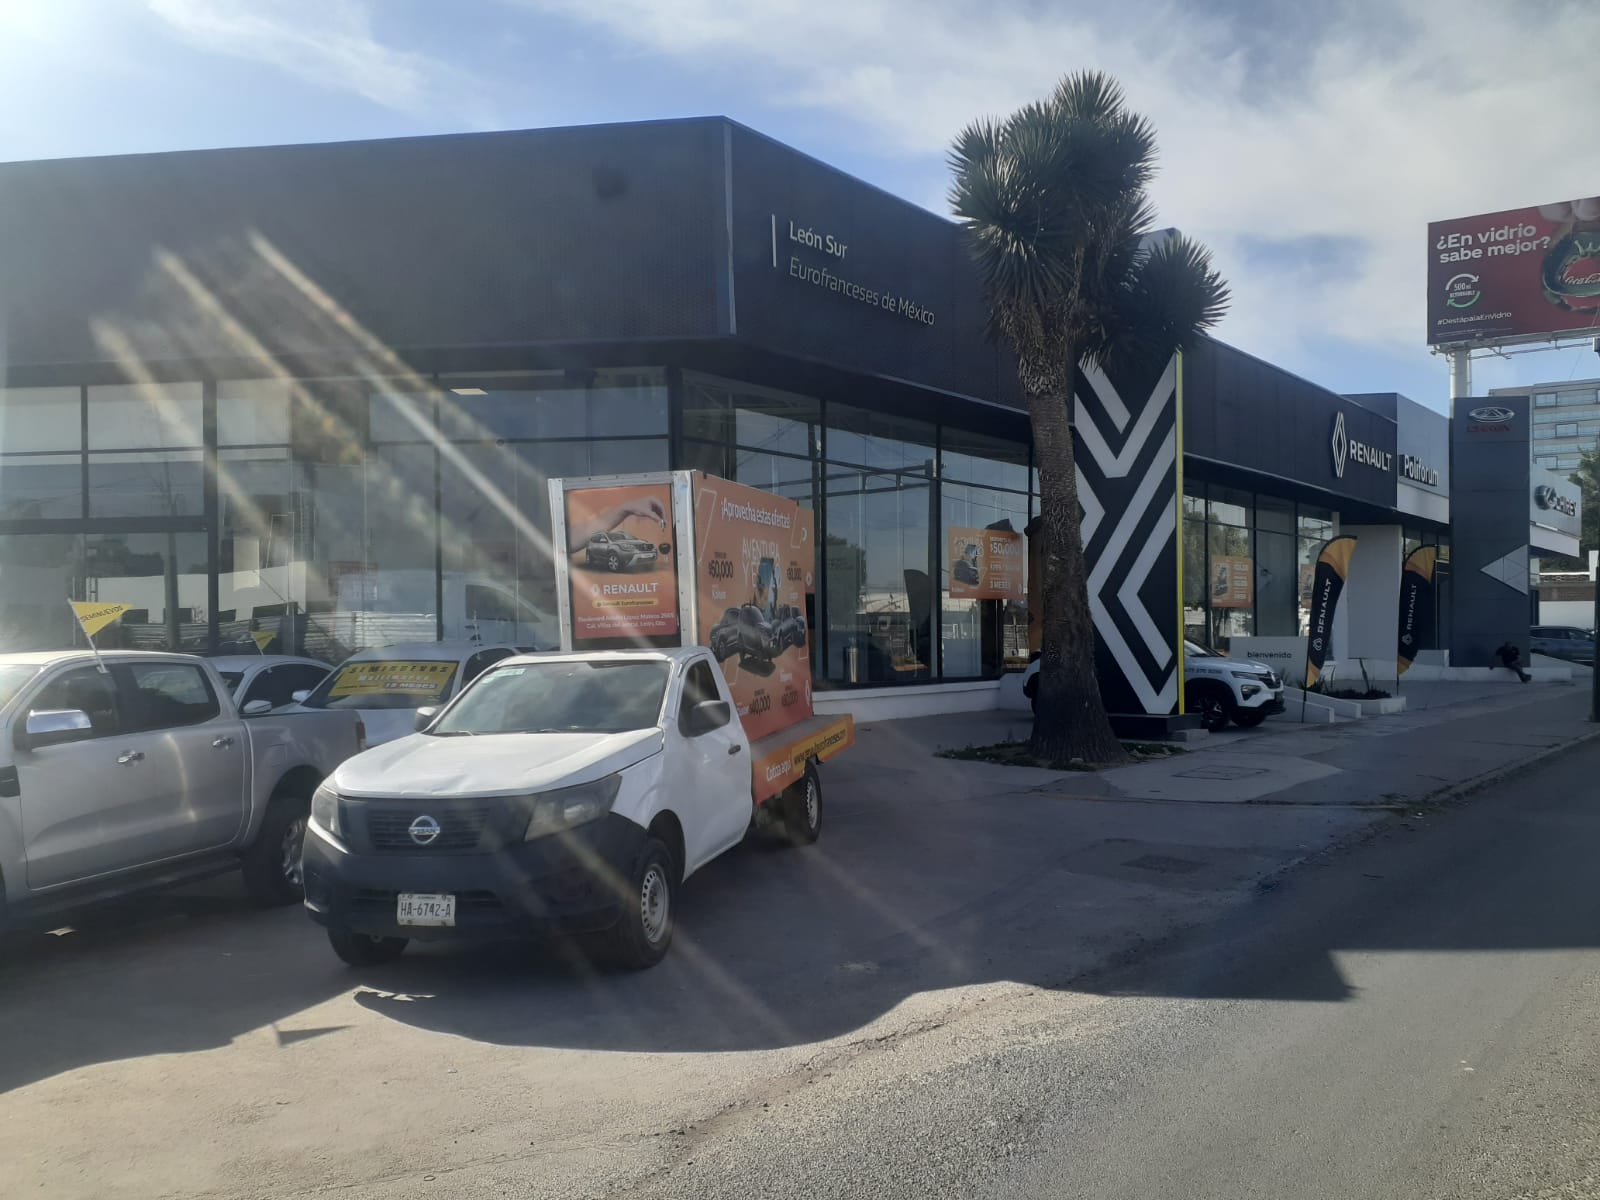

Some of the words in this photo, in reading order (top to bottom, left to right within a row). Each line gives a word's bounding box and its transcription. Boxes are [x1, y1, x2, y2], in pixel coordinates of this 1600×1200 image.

[789, 220, 823, 251] León
[826, 234, 848, 259] Sur
[1436, 232, 1473, 250] ¿En
[1477, 222, 1537, 244] vidrio
[1439, 247, 1483, 264] sabe
[1487, 235, 1551, 257] mejor?
[789, 255, 880, 306] Eurofranceses
[881, 291, 897, 312] de
[898, 296, 936, 326] México
[1349, 439, 1393, 473] RENAULT
[1403, 453, 1440, 488] Poliforum
[742, 537, 781, 563] AVENTURA
[603, 582, 659, 595] RENAULT
[79, 604, 124, 623] SEMINUEVOS
[1317, 578, 1332, 634] RENAULT
[1406, 583, 1417, 631] RENAULT
[1247, 650, 1292, 659] bienvenido
[400, 901, 452, 918] HA-6742-A
